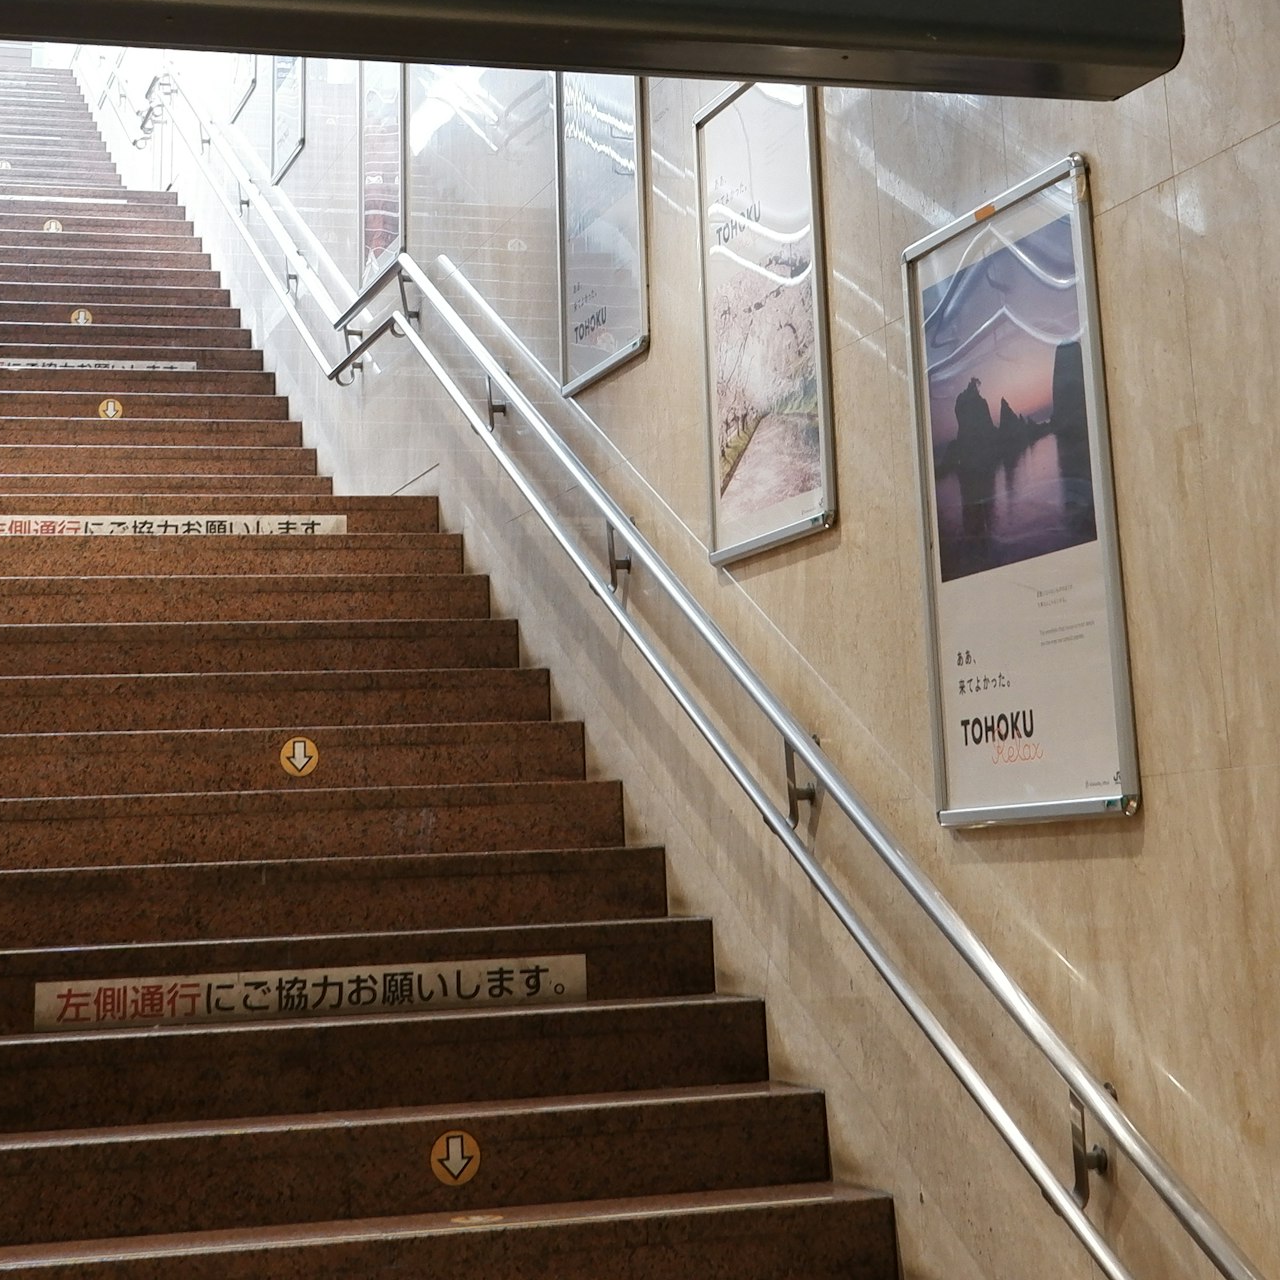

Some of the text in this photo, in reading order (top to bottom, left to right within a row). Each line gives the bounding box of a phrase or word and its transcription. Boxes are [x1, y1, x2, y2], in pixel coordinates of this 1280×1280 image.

[715, 200, 762, 246] TOHOKU
[573, 305, 608, 345] TOHOKU
[956, 649, 977, 667] ああ、
[958, 672, 1012, 696] 来てよかった。
[960, 708, 1035, 747] TOHOKU
[991, 727, 1044, 765] Relax
[56, 964, 568, 1025] 左側通行にご協力お願いします。
